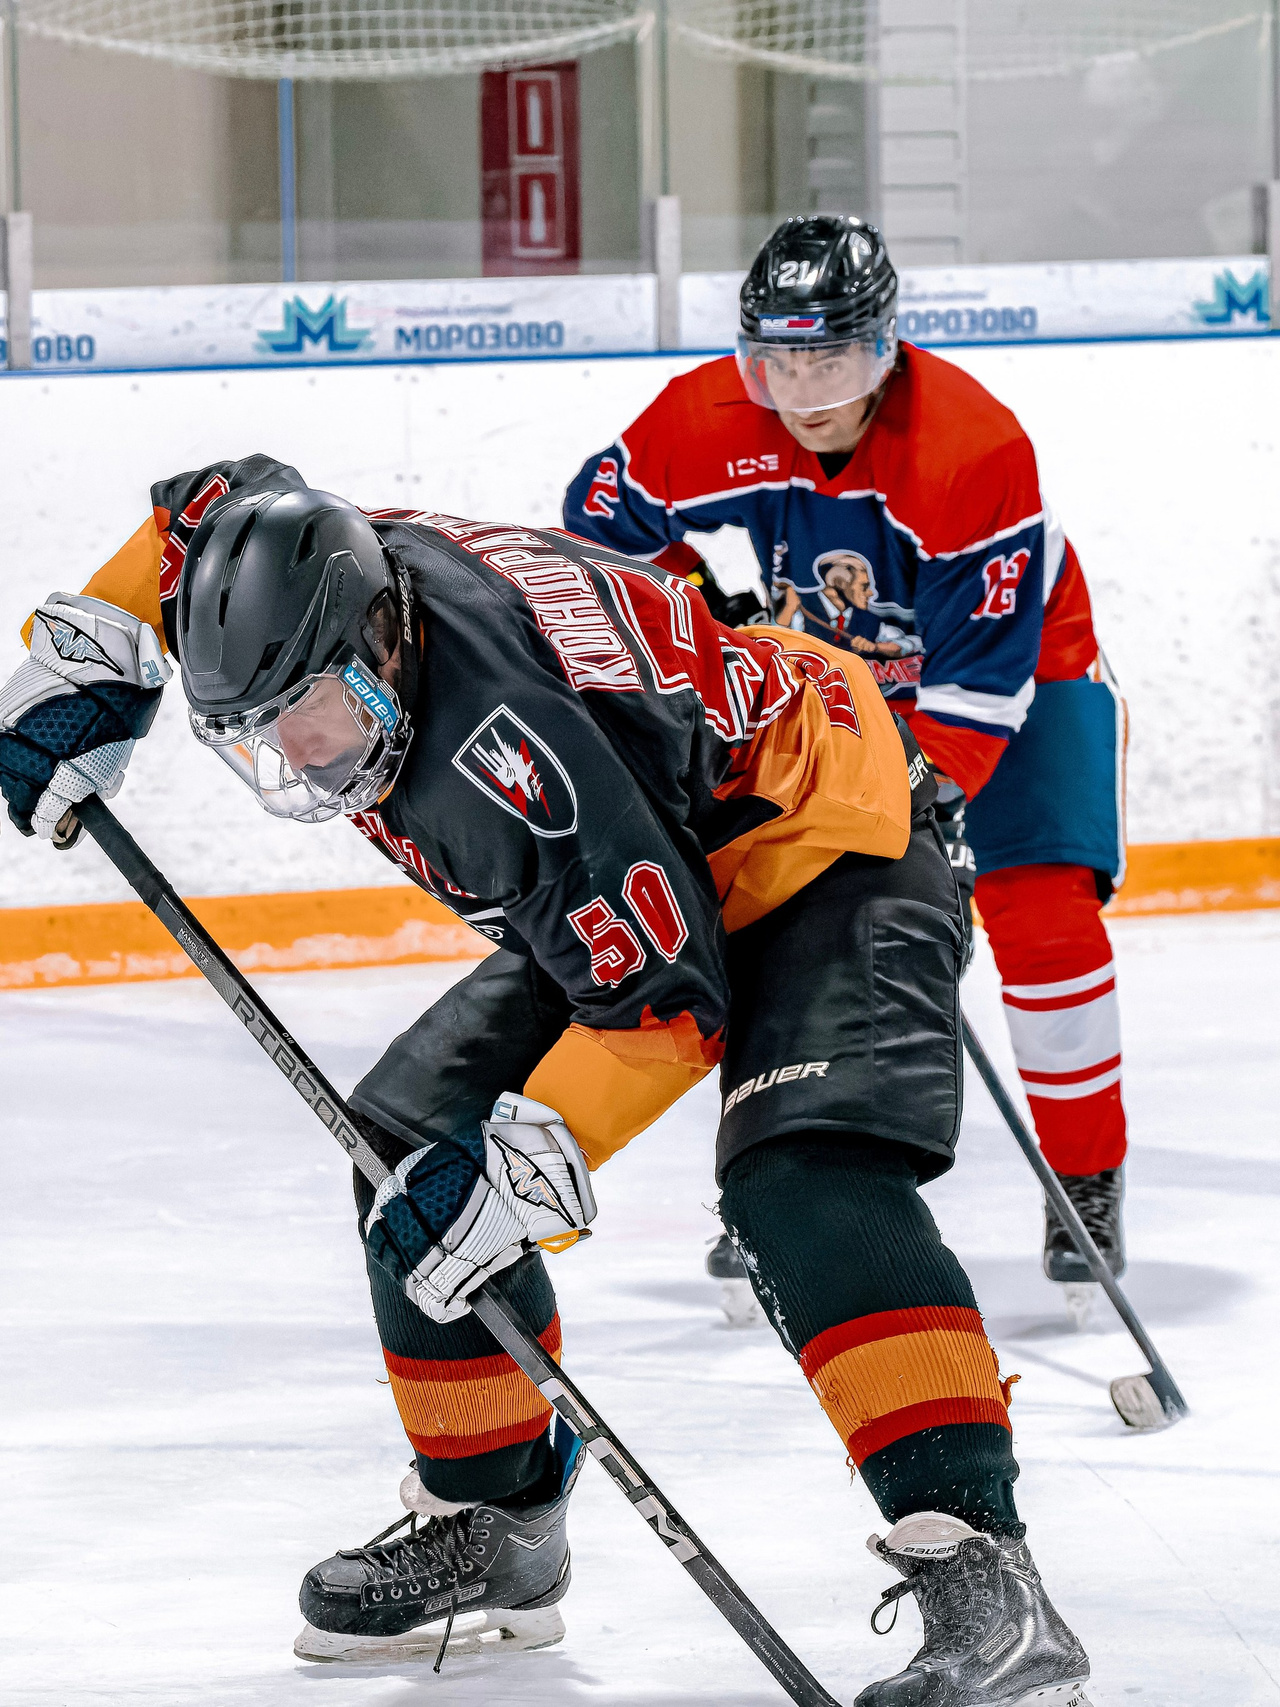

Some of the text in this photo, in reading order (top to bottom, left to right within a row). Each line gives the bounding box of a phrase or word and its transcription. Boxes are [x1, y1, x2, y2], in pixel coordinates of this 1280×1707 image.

[777, 260, 810, 288] 21
[395, 321, 565, 351] МОРОЗОВО
[898, 306, 1038, 335] ОРОЗОВО
[970, 548, 1031, 620] 12
[566, 860, 689, 988] 50
[232, 993, 358, 1151] RIBCOR
[723, 1060, 830, 1117] BAUER
